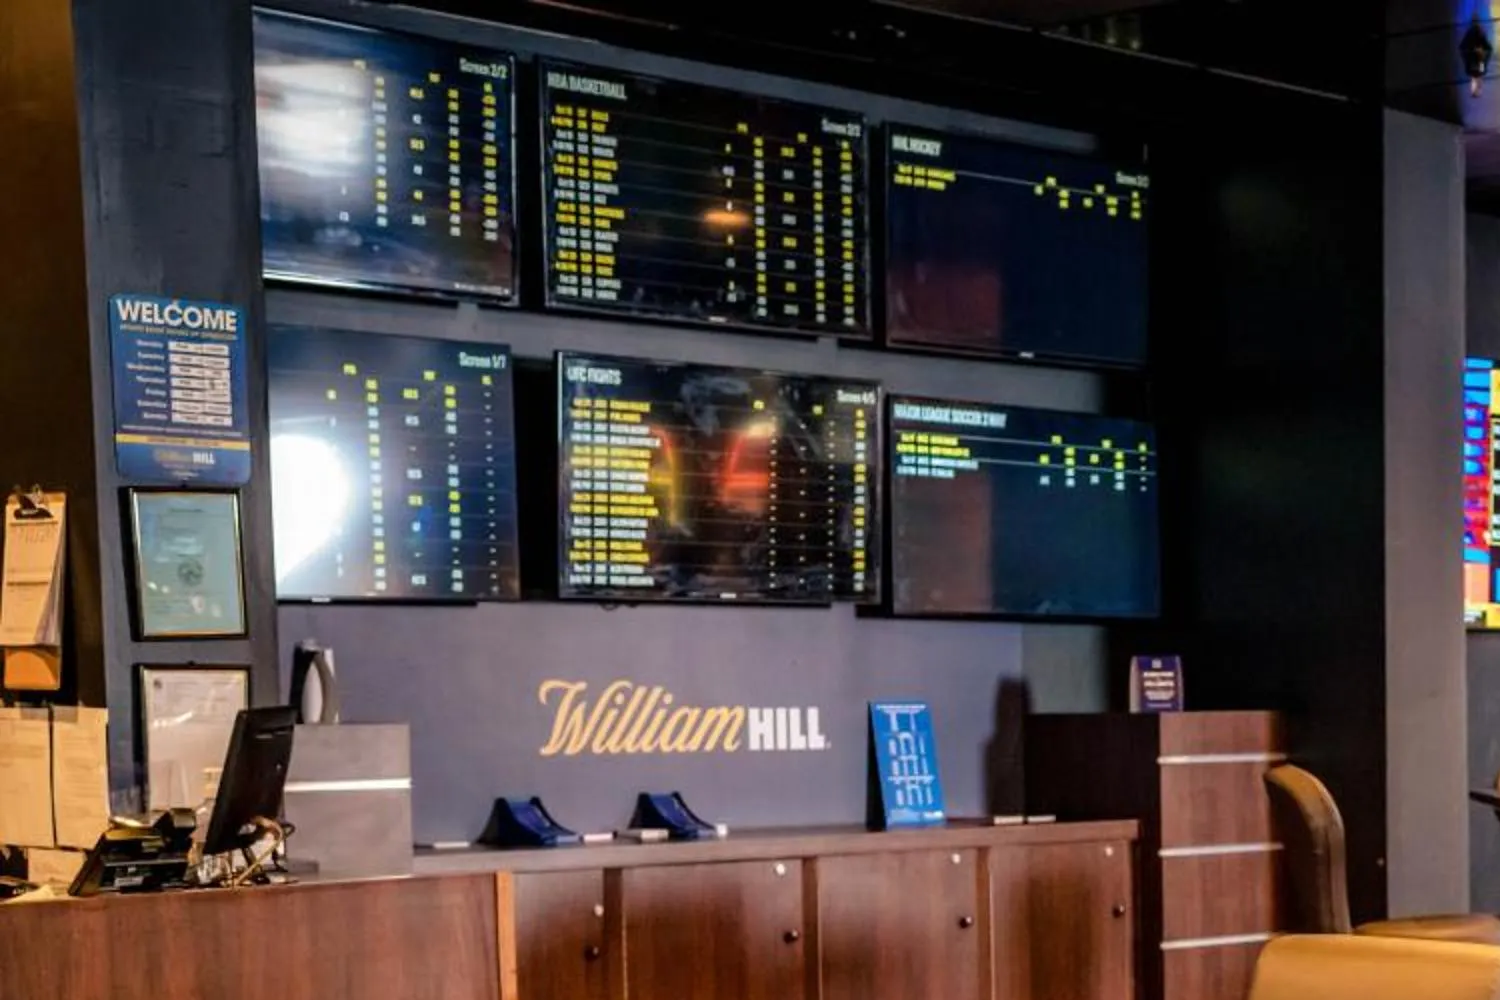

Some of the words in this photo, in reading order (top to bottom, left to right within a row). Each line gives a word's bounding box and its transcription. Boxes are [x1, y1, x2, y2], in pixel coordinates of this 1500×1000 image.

[569, 75, 627, 101] BASKETBALL
[117, 299, 237, 331] WELCOME
[459, 351, 491, 368] Screen
[538, 679, 746, 757] William
[747, 706, 826, 751] HILL
